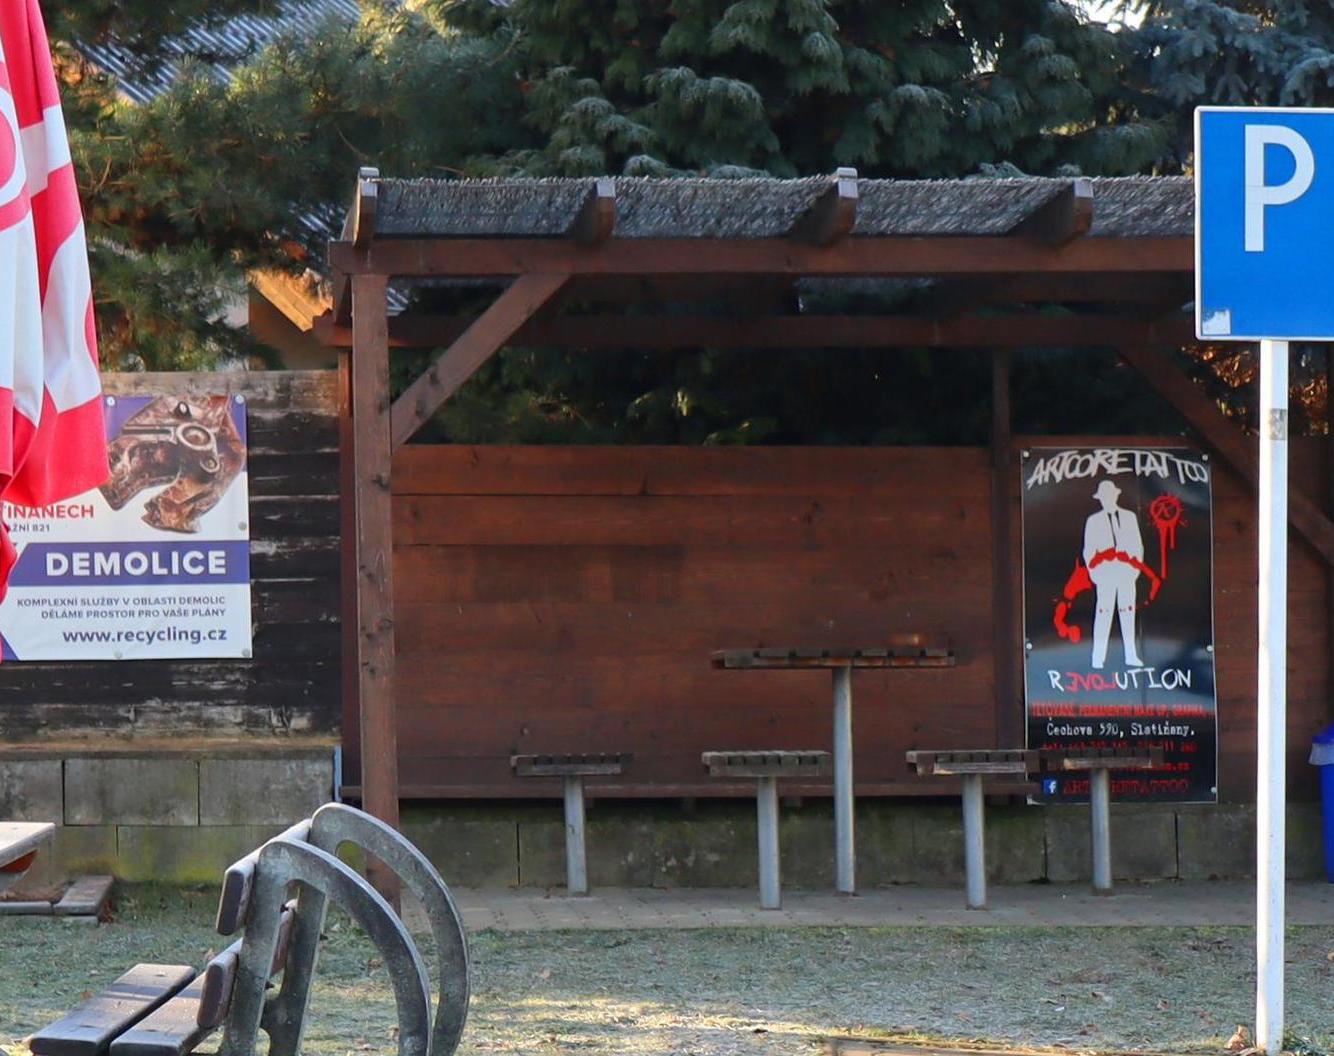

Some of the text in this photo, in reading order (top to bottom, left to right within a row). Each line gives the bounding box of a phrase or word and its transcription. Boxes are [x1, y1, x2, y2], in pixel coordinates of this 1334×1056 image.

[1244, 124, 1315, 252] P
[46, 550, 227, 577] DEMOLICE
[17, 596, 226, 607] KOMPLEXNÍ SLUŽBY V OBLASTI DEMOLIC
[41, 607, 226, 619] DĚLÁME PROSTOR PRO VAŠE PLÁNY
[63, 626, 227, 645] www.recycling.cz
[1046, 717, 1093, 736] Čechova
